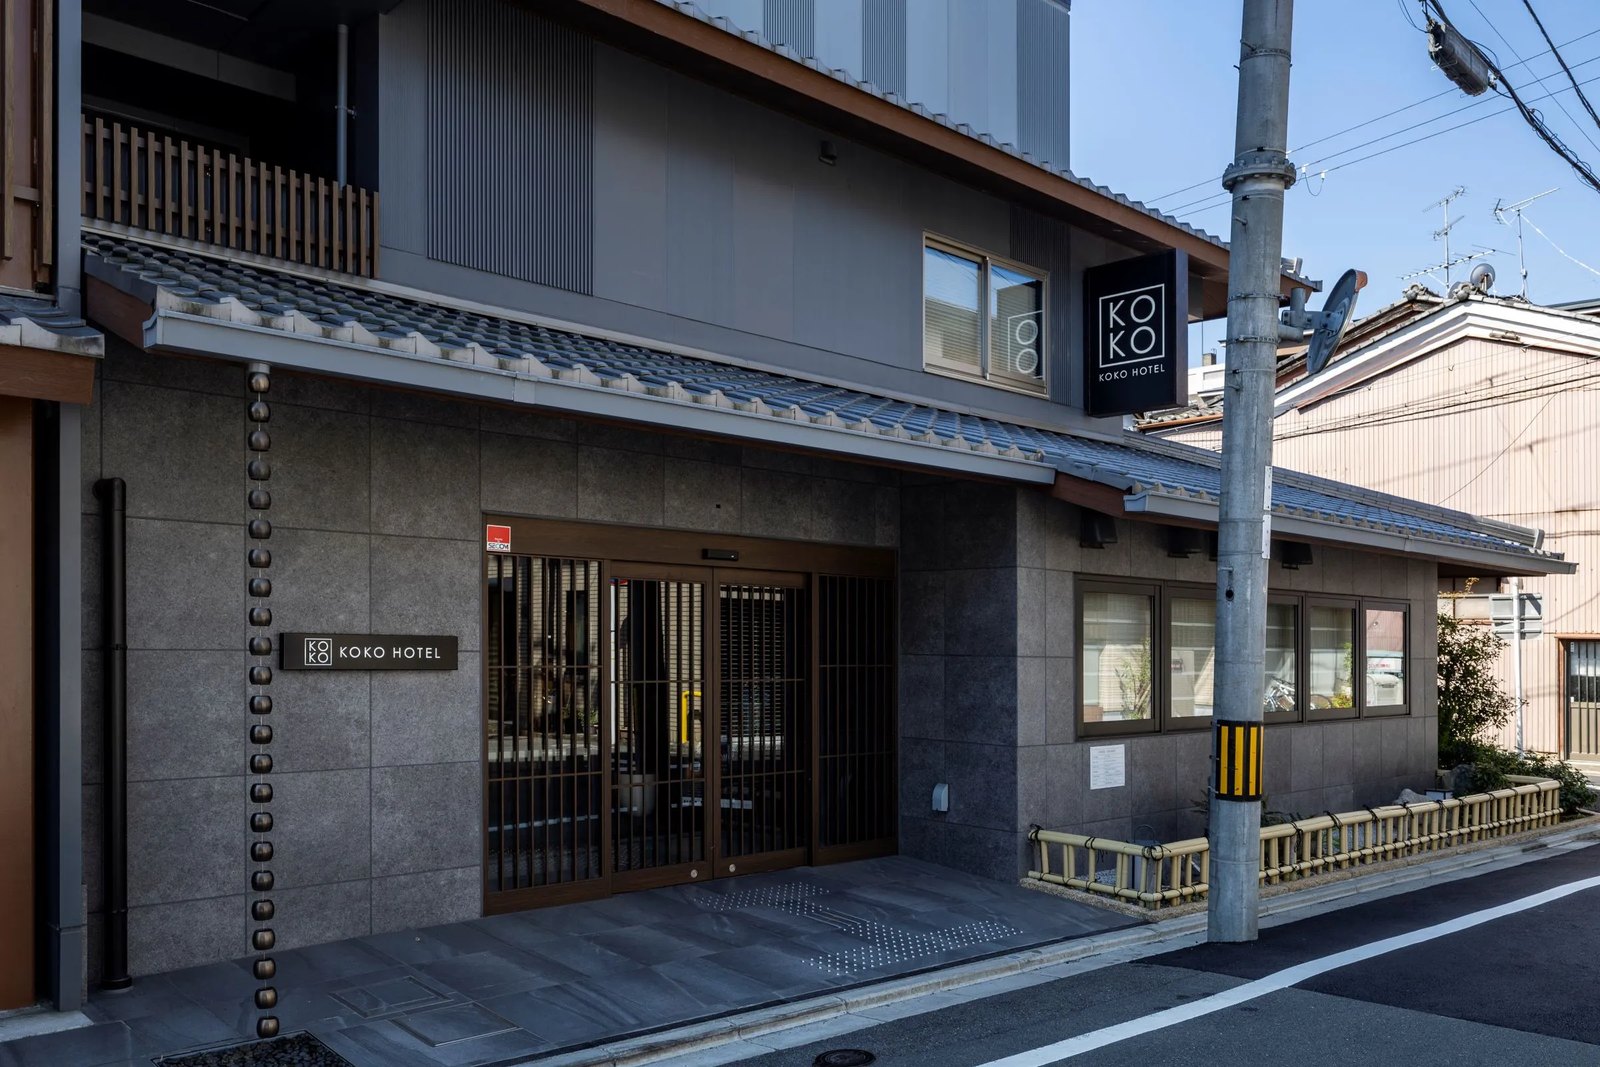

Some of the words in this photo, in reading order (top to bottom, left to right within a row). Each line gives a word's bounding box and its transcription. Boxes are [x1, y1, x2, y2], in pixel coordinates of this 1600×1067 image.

[1109, 294, 1156, 328] KO
[1109, 325, 1156, 359] KO
[1099, 369, 1128, 382] KOKO
[1132, 363, 1165, 377] HOTEL
[488, 542, 509, 550] SECOM
[308, 640, 329, 652] KO
[339, 646, 385, 659] KOKO
[392, 647, 441, 659] HOTEL
[308, 652, 329, 663] KO
